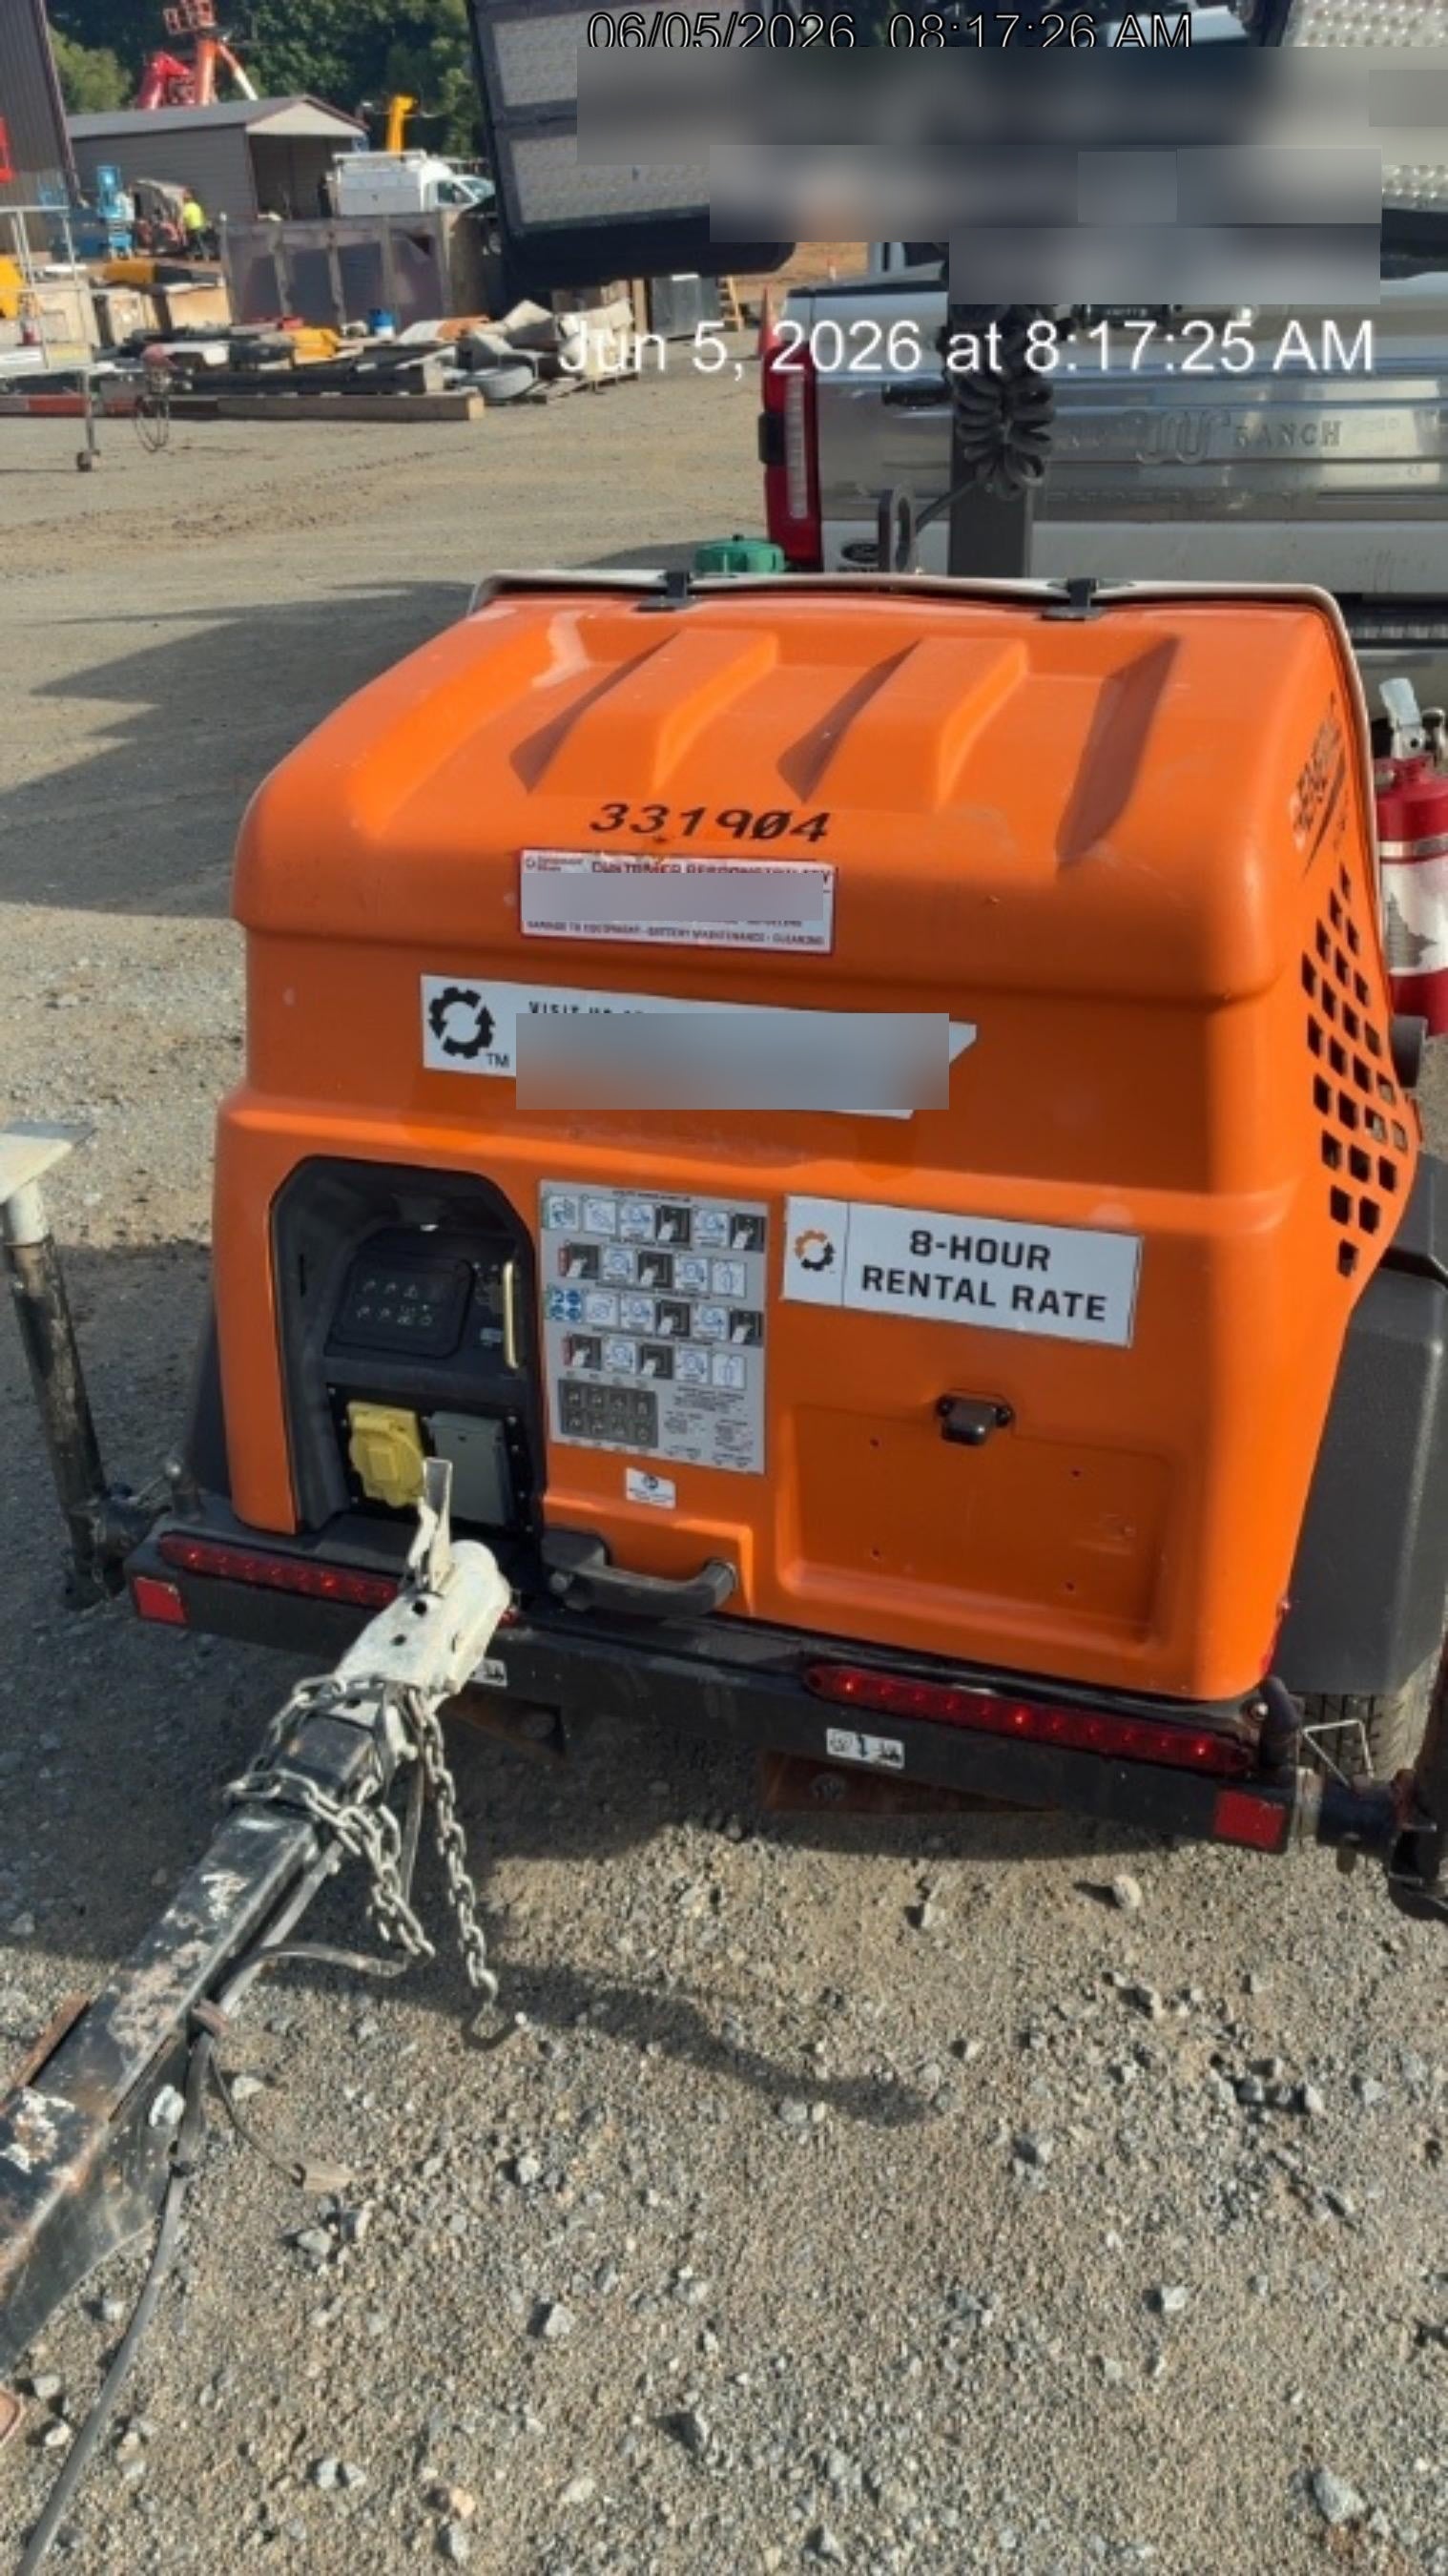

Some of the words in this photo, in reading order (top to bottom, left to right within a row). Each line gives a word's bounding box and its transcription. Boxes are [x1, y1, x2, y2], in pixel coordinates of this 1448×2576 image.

[1233, 419, 1344, 447] RANCH
[589, 802, 831, 842] 331904
[909, 1229, 1051, 1272] 8-HOUR
[860, 1265, 997, 1308] RENTAL
[1011, 1284, 1107, 1322] RATE
